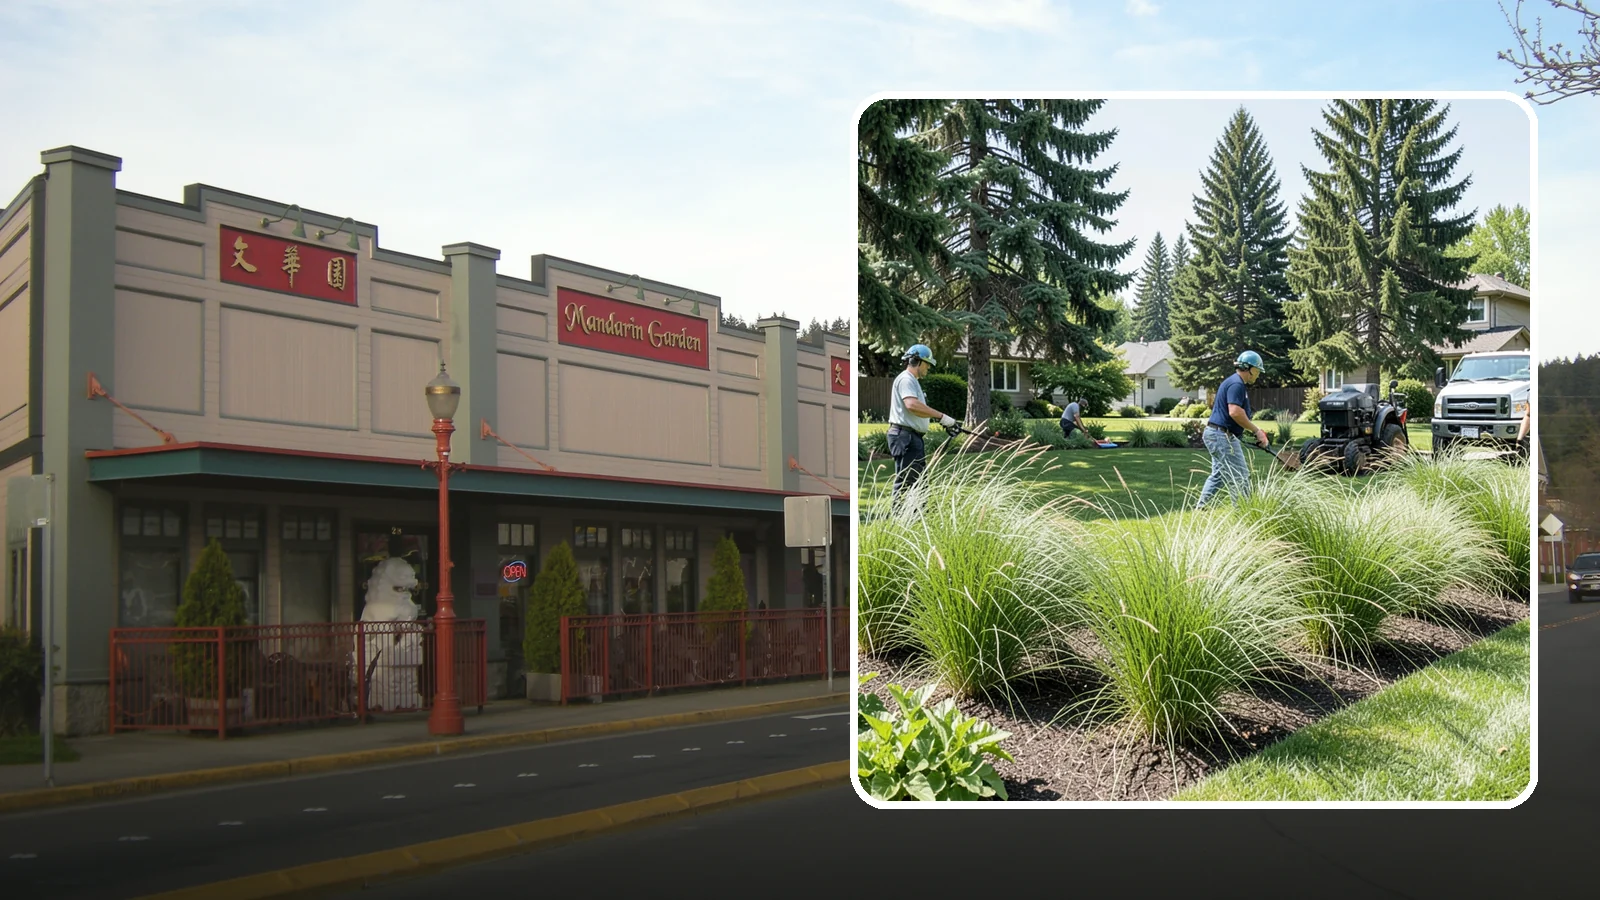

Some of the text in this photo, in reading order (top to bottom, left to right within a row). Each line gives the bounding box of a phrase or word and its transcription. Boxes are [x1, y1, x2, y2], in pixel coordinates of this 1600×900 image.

[230, 235, 346, 291] 文華園
[564, 302, 701, 352] Mandarin Garden
[391, 526, 402, 535] 28
[503, 565, 526, 578] OPEN
